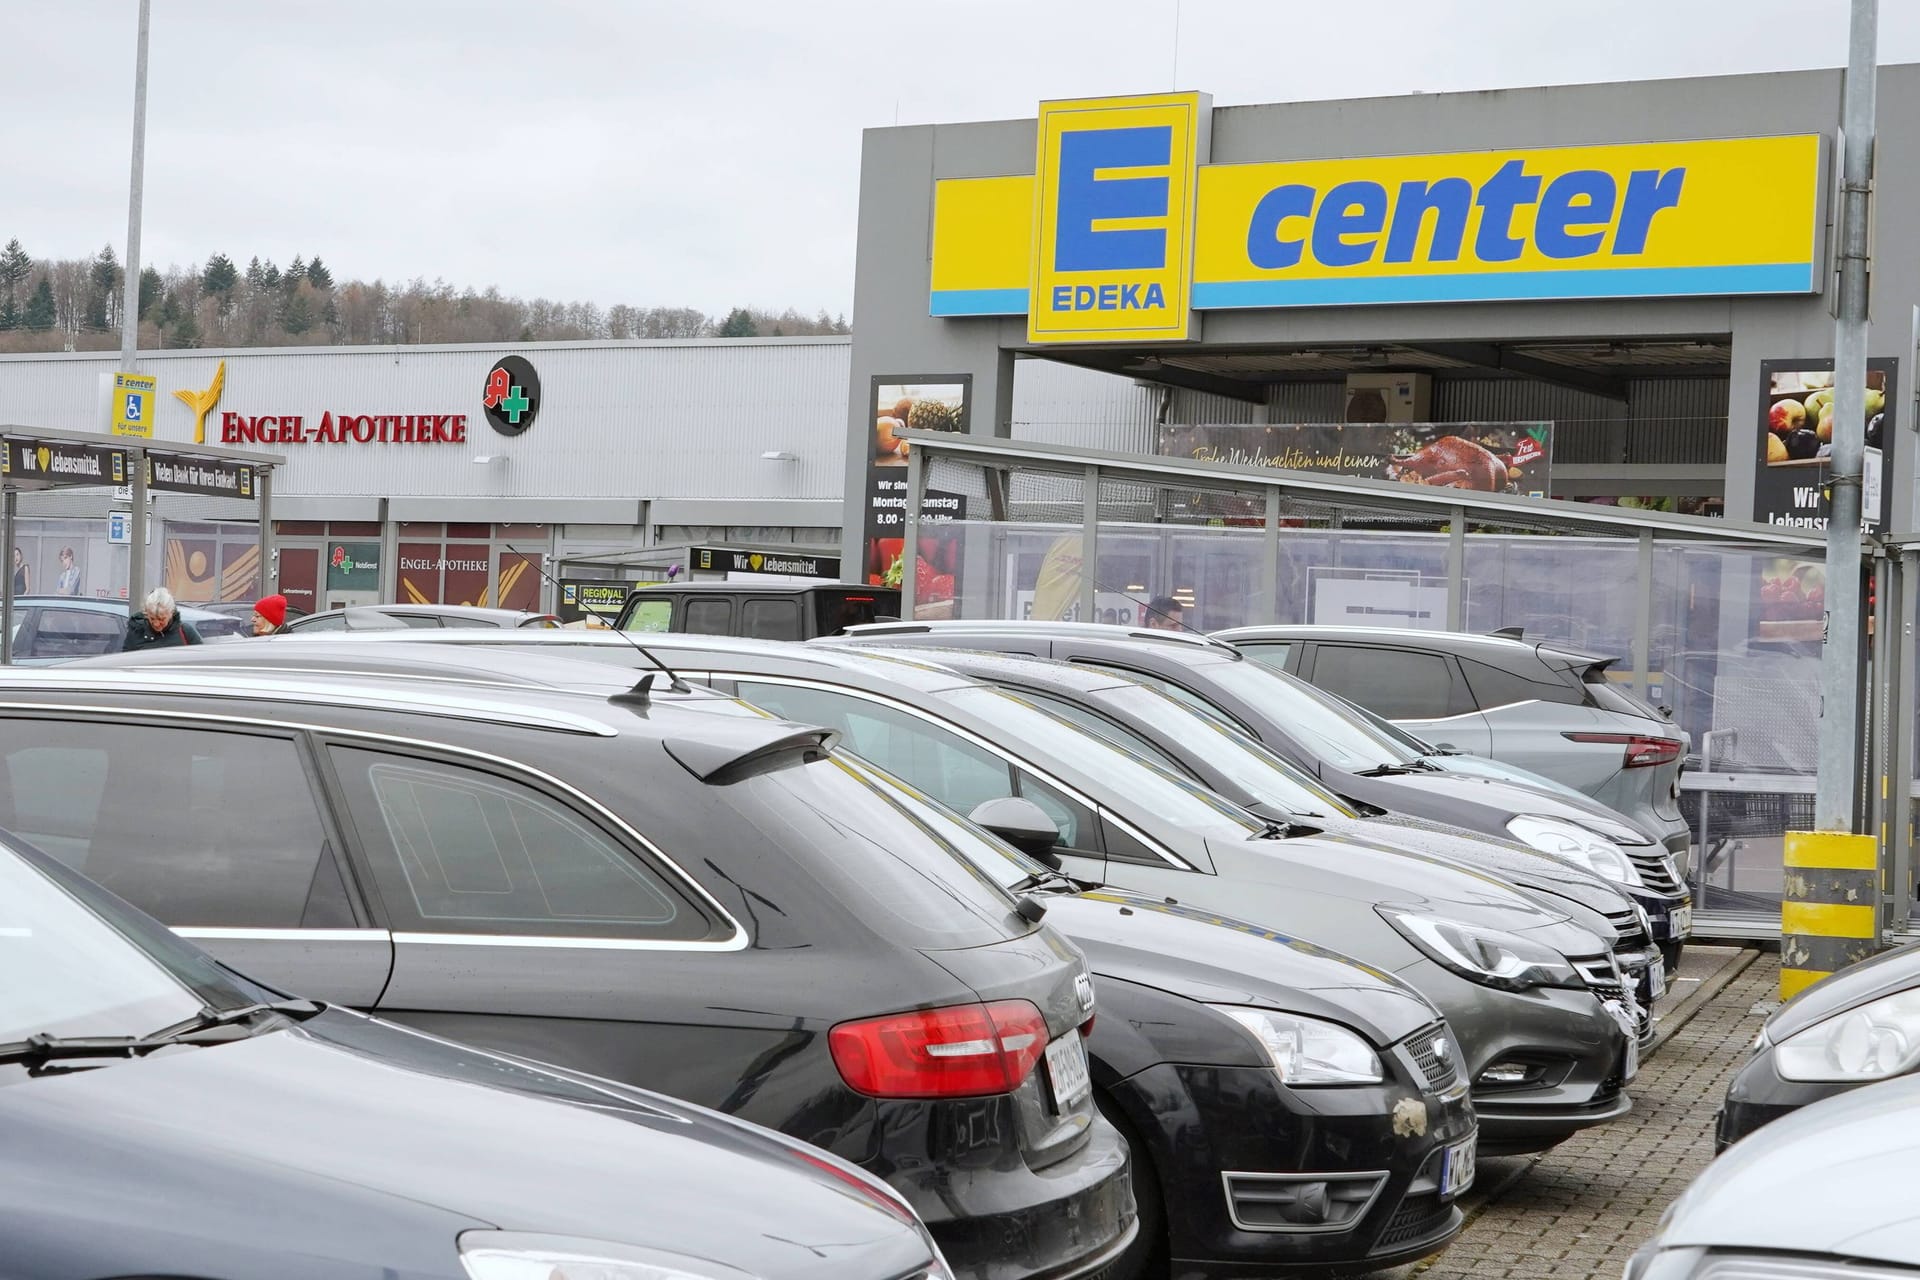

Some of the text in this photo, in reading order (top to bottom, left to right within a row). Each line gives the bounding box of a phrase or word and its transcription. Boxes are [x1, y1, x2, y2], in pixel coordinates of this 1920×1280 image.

[1054, 125, 1172, 272] E
[1247, 160, 1686, 269] center
[1052, 283, 1166, 312] EDEKA
[126, 380, 153, 389] center
[128, 425, 147, 433] unsere
[220, 410, 467, 443] ENGEL-APOTHEKE
[22, 448, 101, 476] Wir Lebensmittel.
[1229, 446, 1316, 469] Weihnachten
[1316, 447, 1344, 471] und
[1344, 458, 1380, 468] einen
[155, 462, 173, 482] Vielen
[199, 467, 214, 487] Ihren
[878, 481, 892, 490] Wir
[921, 498, 959, 509] amstag
[1793, 487, 1820, 508] Wir
[877, 514, 898, 524] 8.00
[400, 557, 488, 572] ENGEL-APOTHEKE
[733, 554, 818, 574] Wir Lebensmittel.
[583, 587, 624, 598] REGIONAL
